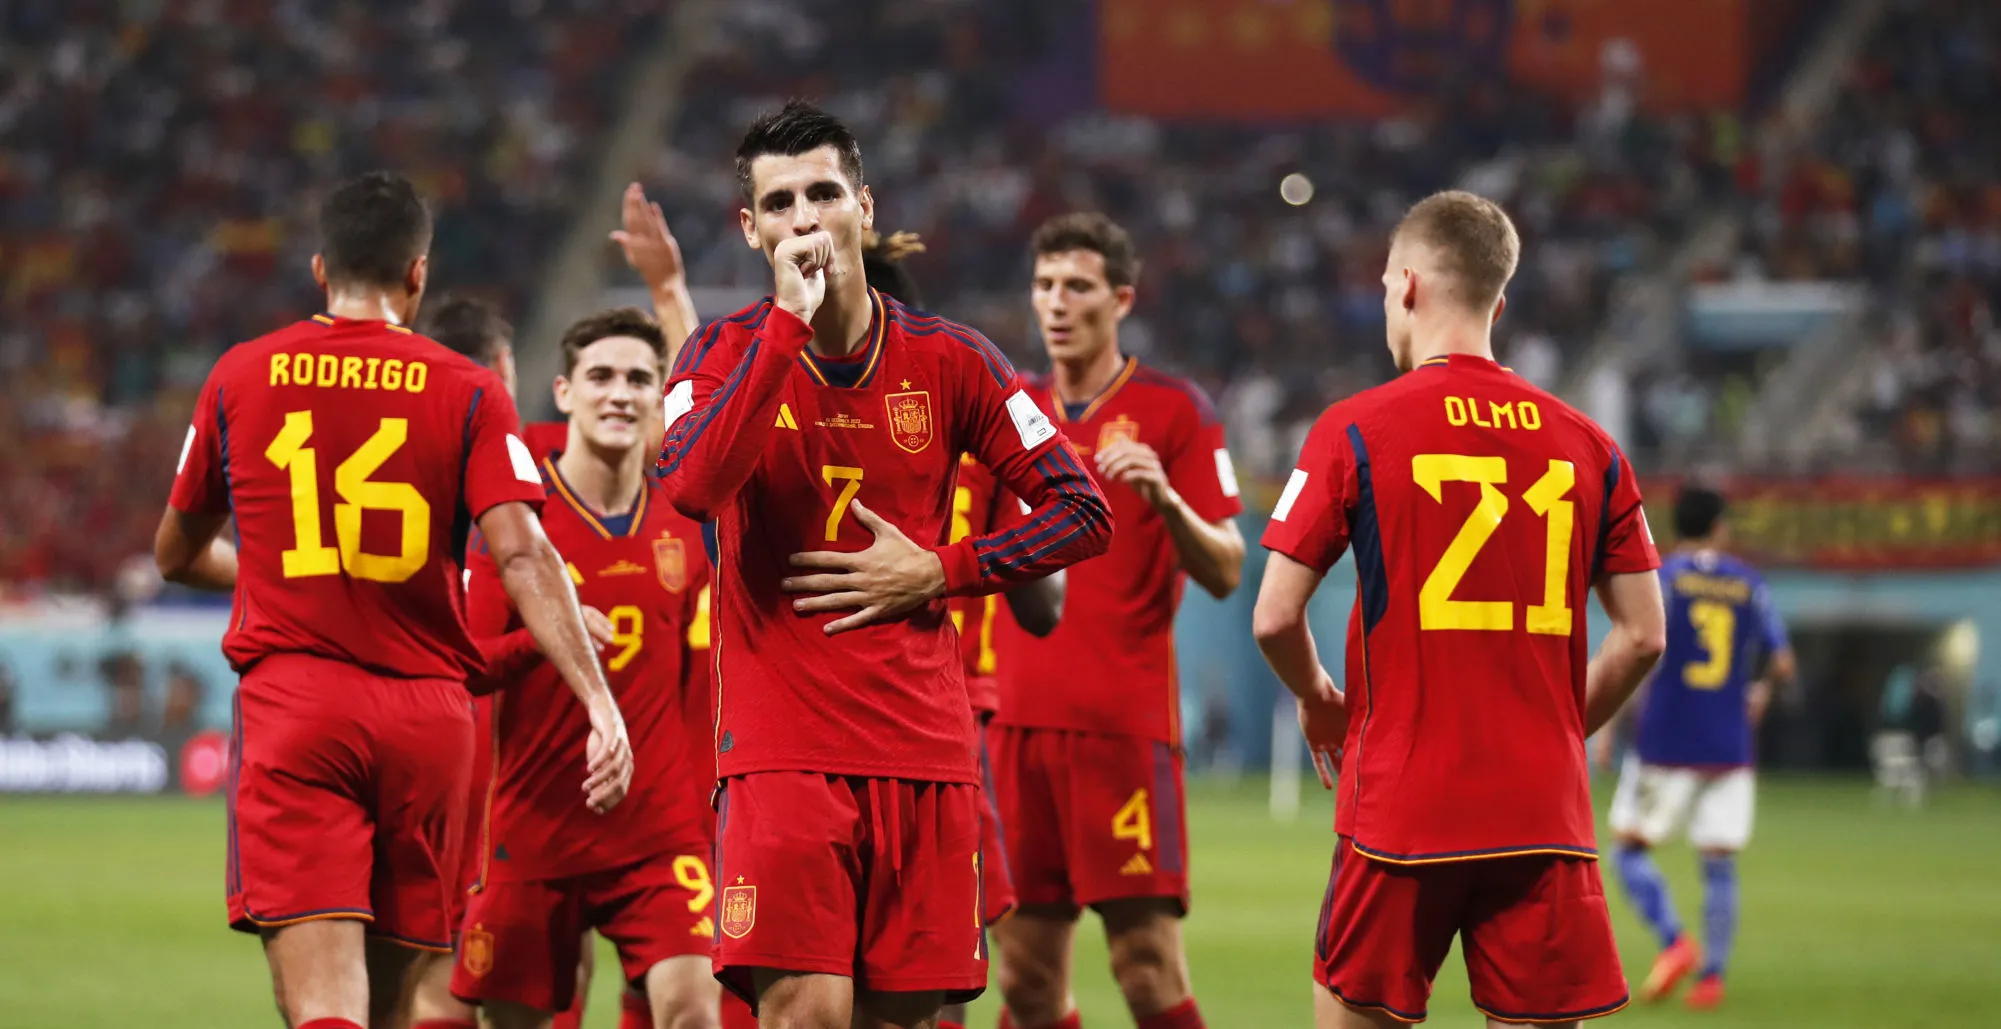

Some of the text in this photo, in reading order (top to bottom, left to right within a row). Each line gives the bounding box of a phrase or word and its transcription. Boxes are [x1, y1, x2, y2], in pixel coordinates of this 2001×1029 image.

[269, 353, 427, 391] RODRIGO
[1444, 396, 1542, 430] OLMO
[265, 410, 431, 580] 16
[822, 466, 863, 540] 7
[1412, 454, 1575, 635] 21
[606, 606, 643, 672] 9
[1683, 601, 1735, 689] 3
[1112, 788, 1152, 849] 4
[673, 856, 714, 912] 9
